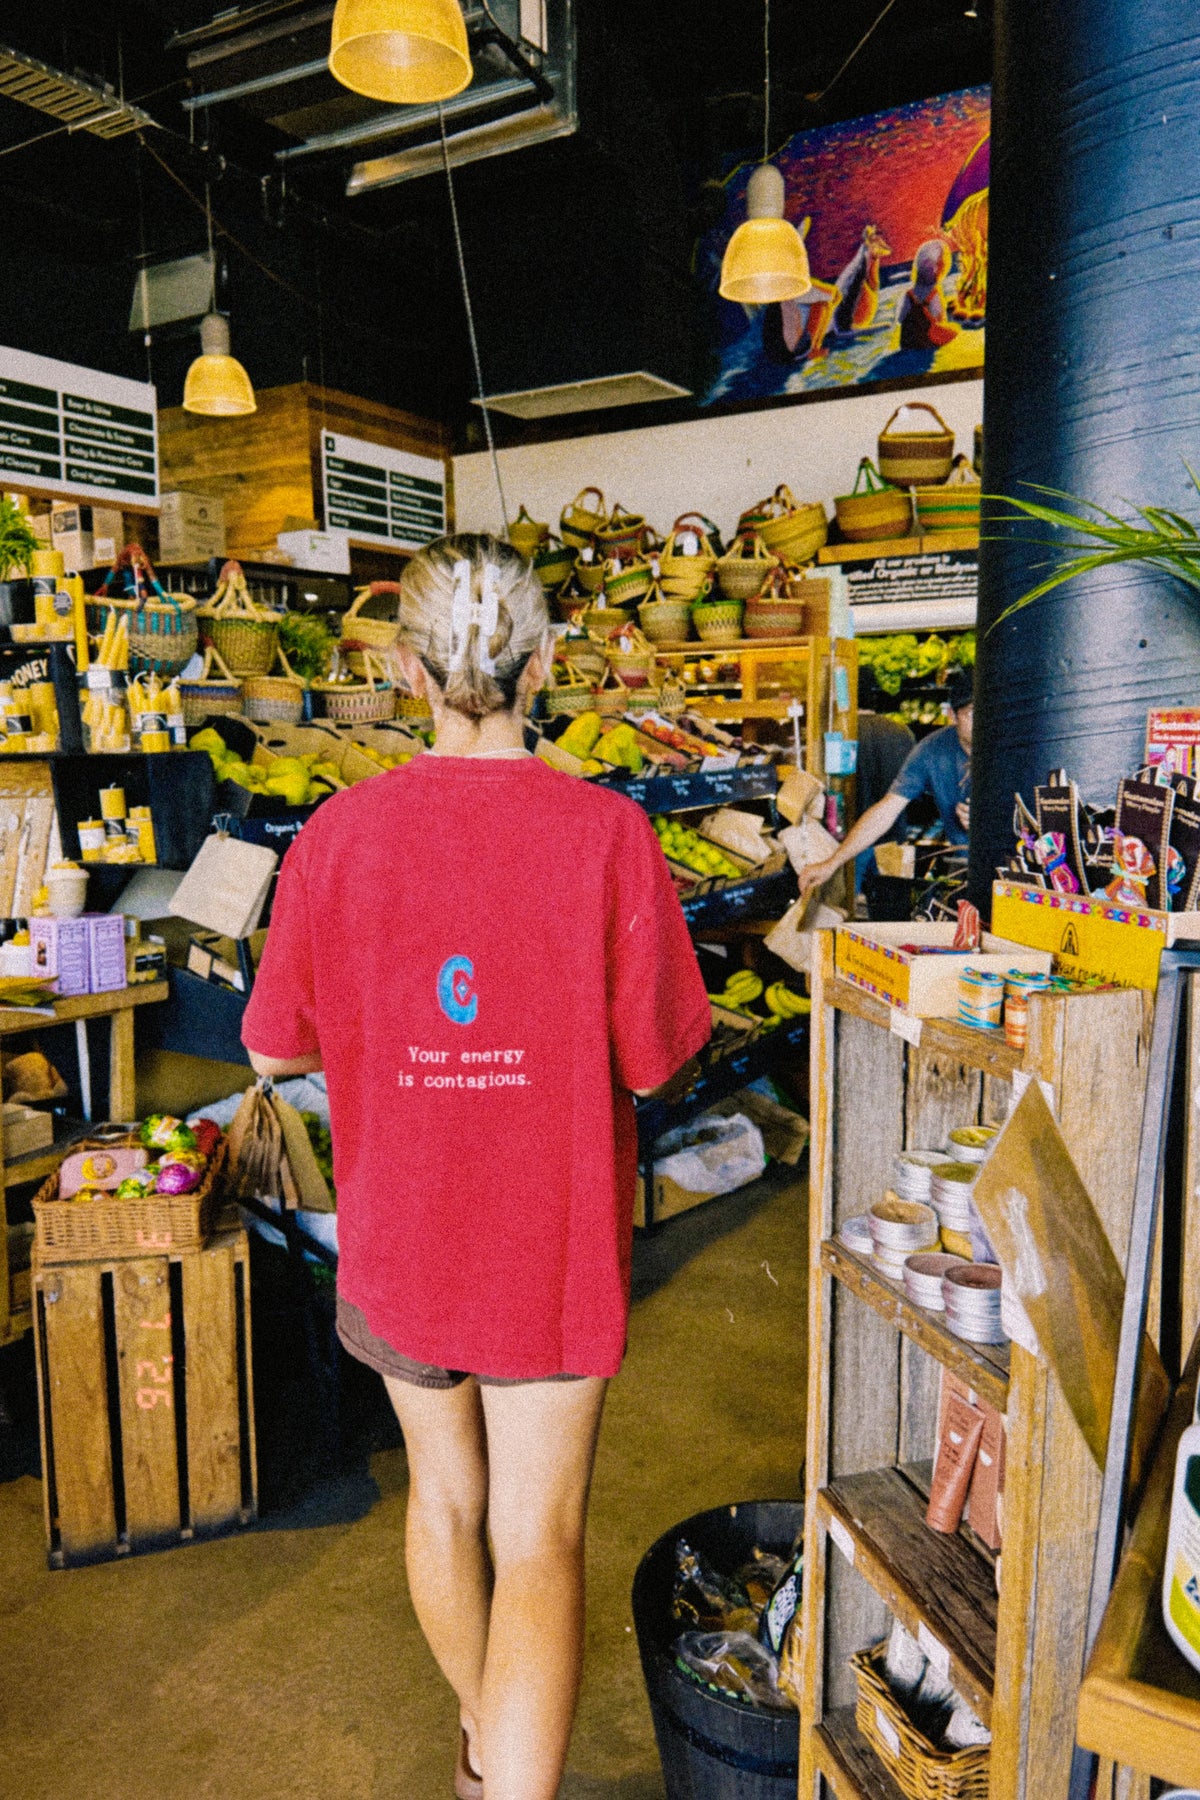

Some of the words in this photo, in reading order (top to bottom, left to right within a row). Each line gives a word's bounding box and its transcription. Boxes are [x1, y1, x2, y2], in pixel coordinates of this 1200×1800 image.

[408, 1046, 450, 1064] Your
[460, 1048, 526, 1065] energy
[398, 1070, 414, 1087] is
[424, 1071, 532, 1090] contagious.
